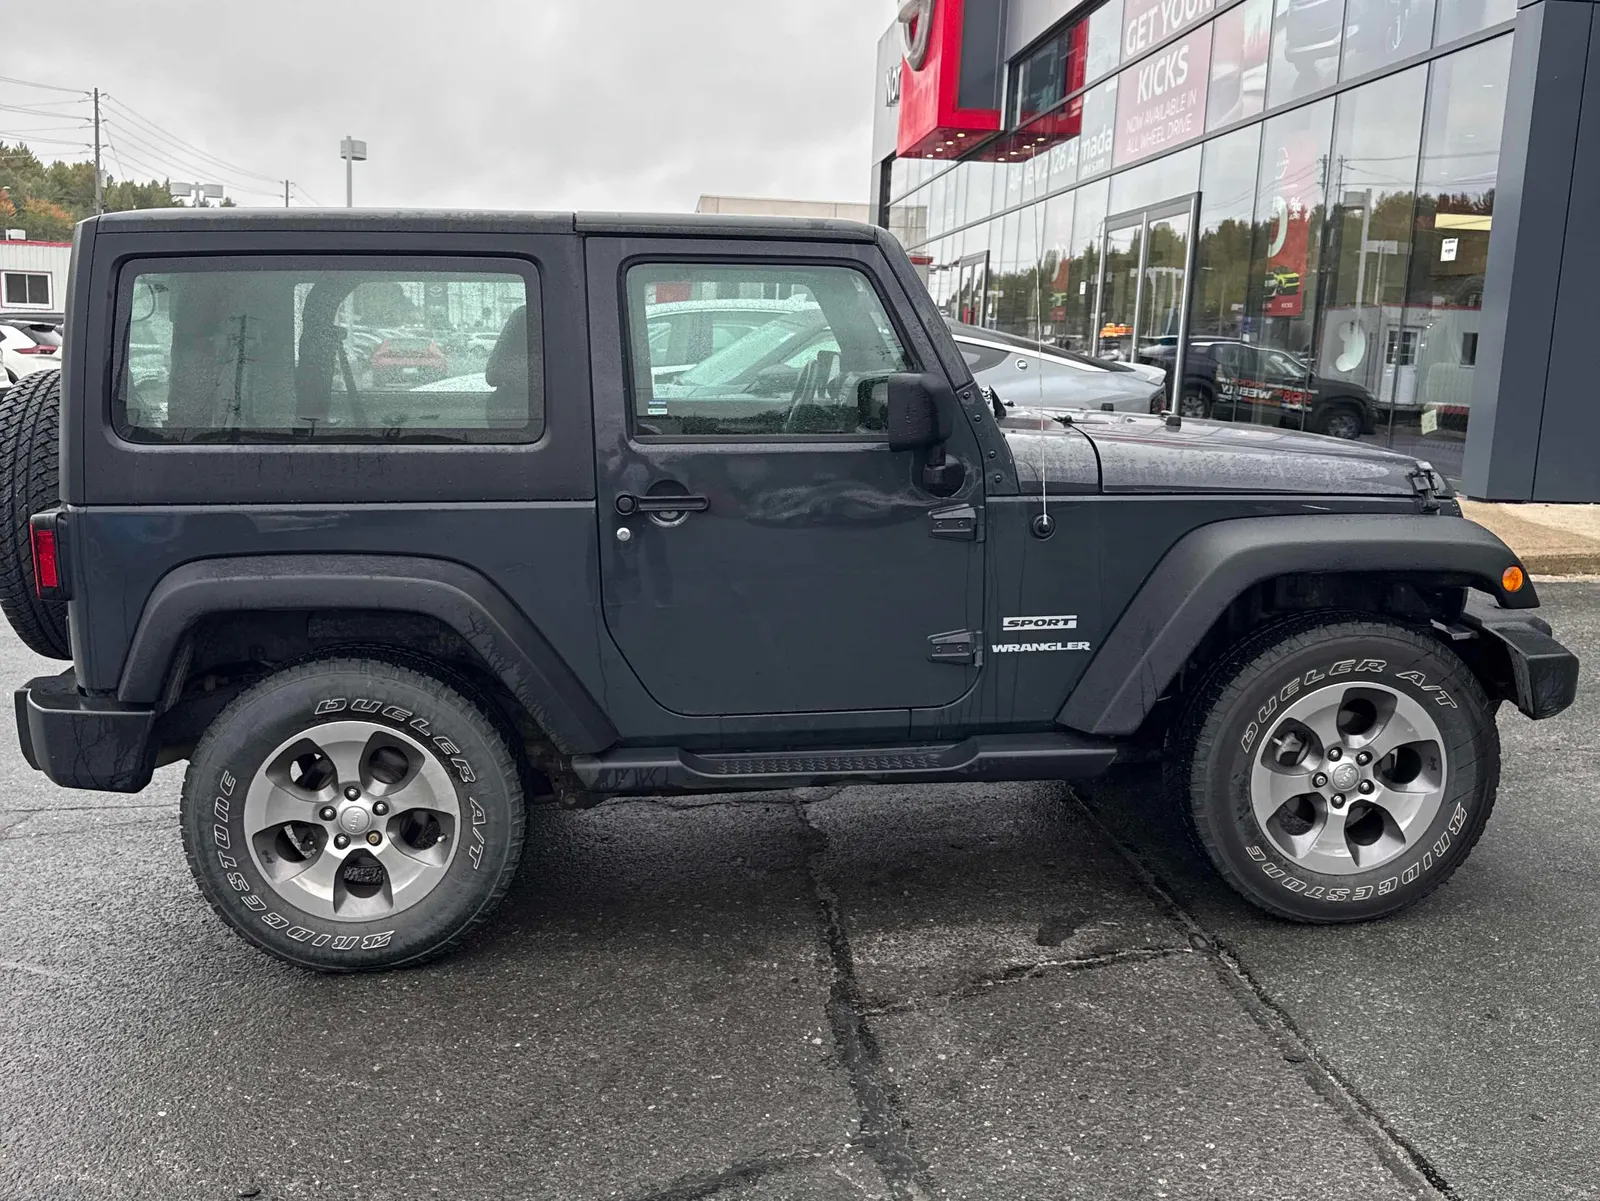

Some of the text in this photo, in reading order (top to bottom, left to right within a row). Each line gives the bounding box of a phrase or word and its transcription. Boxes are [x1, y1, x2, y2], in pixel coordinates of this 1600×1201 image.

[1126, 5, 1158, 56] GET
[1137, 44, 1189, 104] KICKS
[1126, 87, 1198, 135] NOW AVAILABLE IN
[1126, 112, 1193, 153] ALL WHEEL DRIVE
[992, 641, 1091, 653] WRANGLER
[1003, 617, 1077, 629] SPORT
[1240, 659, 1458, 753] DUELER A/T
[314, 698, 486, 870] DUELER A/T
[214, 770, 395, 950] BRIDGESTONE
[1245, 801, 1468, 902] BRIDGESTONE
